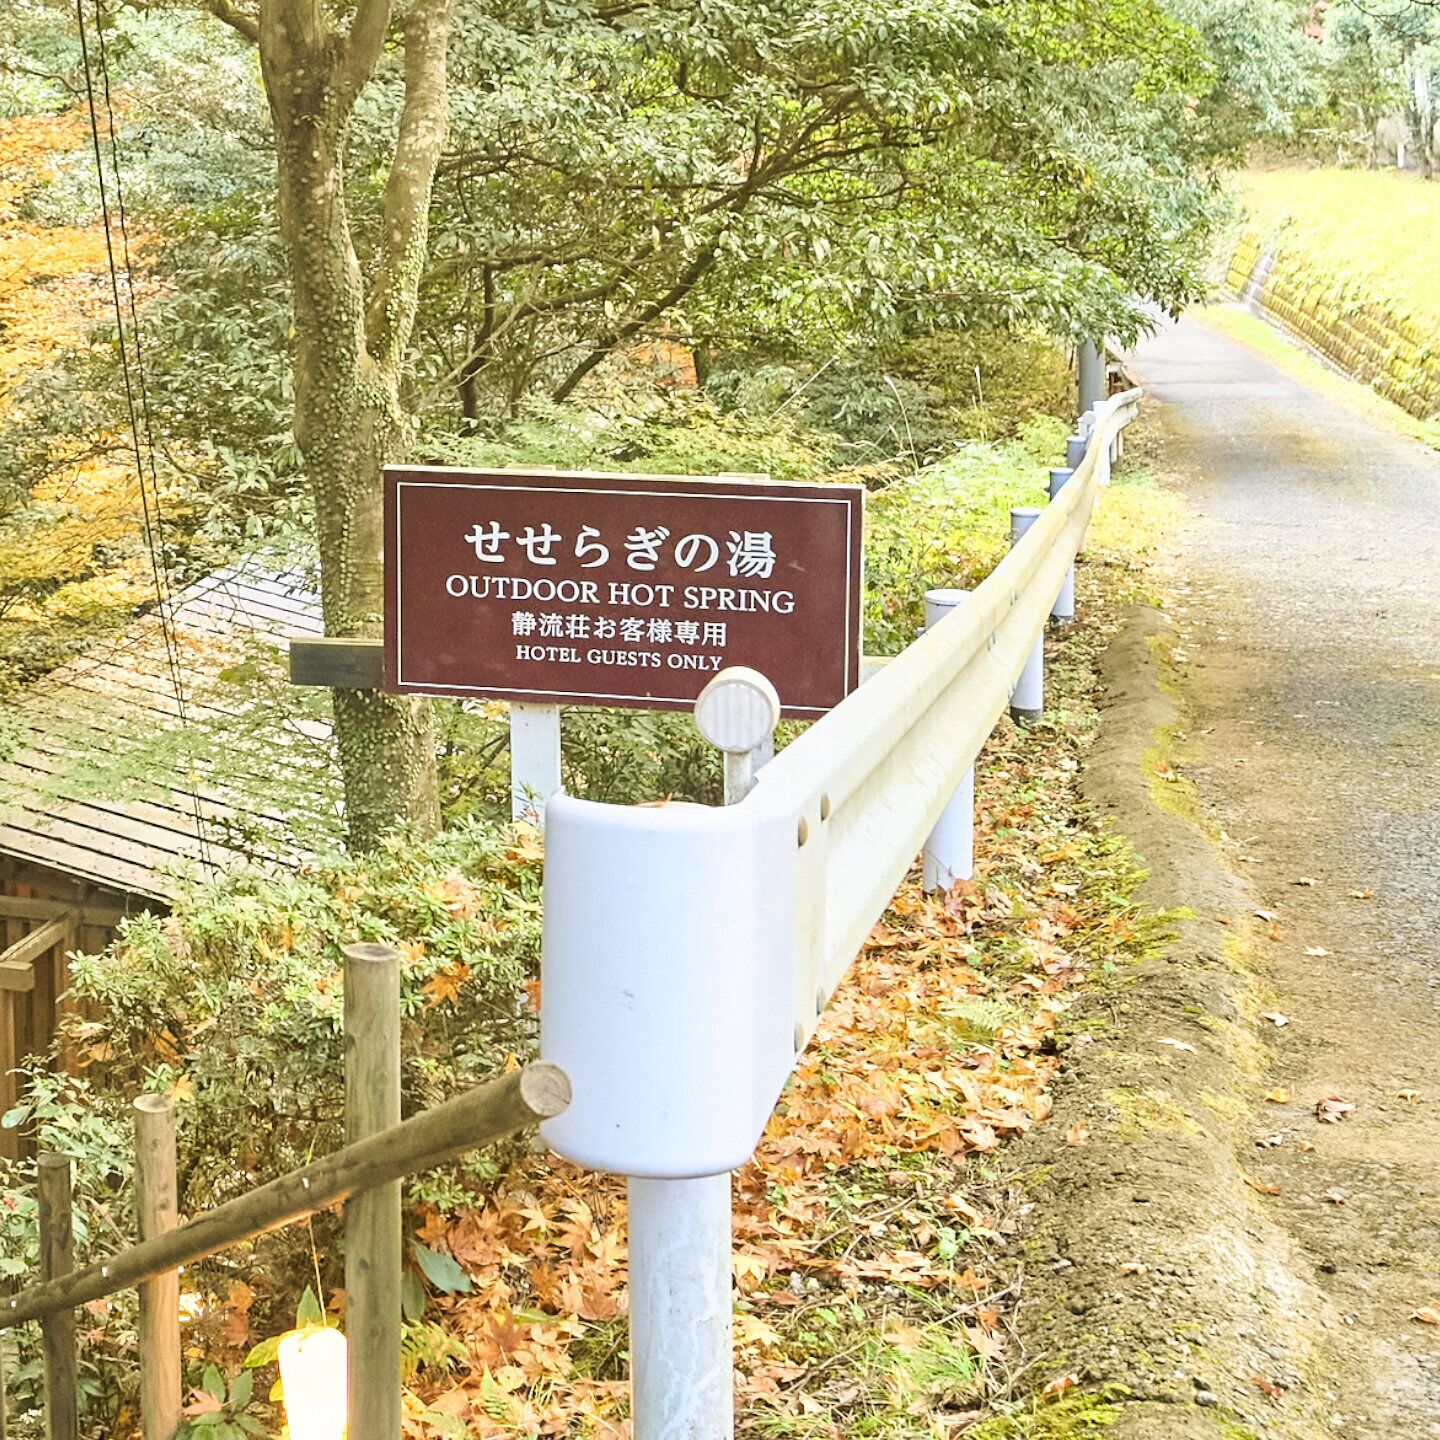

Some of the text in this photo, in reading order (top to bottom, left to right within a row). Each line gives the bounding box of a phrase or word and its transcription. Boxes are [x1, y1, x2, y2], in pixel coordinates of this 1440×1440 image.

[464, 520, 776, 578] せせらぎの湯
[446, 574, 795, 614] OUTDOOR HOT SPRING
[511, 610, 727, 647] 静流荘お客様専用
[516, 645, 723, 671] HOTEL GUESTS ONLY
